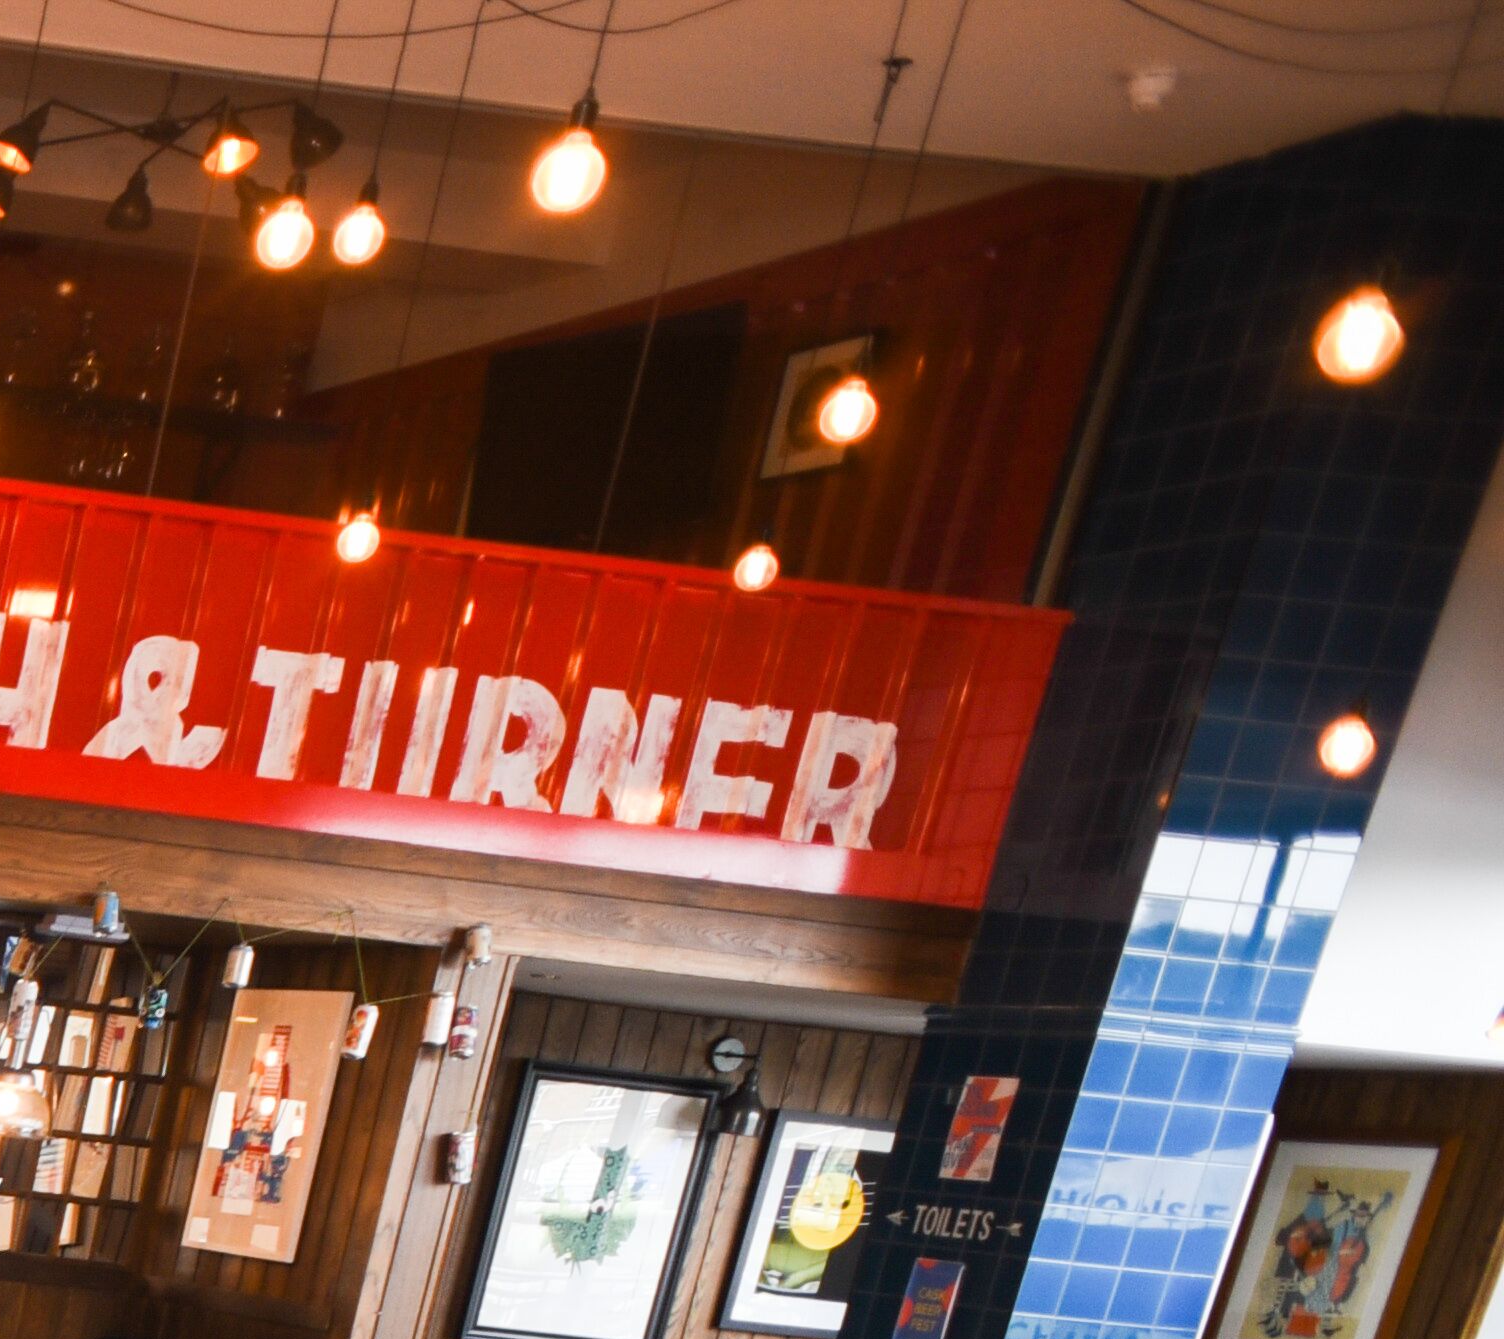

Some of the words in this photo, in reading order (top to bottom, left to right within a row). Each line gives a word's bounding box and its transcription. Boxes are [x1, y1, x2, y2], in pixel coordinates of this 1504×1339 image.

[81, 634, 226, 770] &
[249, 644, 899, 850] TURNER
[912, 1204, 995, 1241] TOILETS
